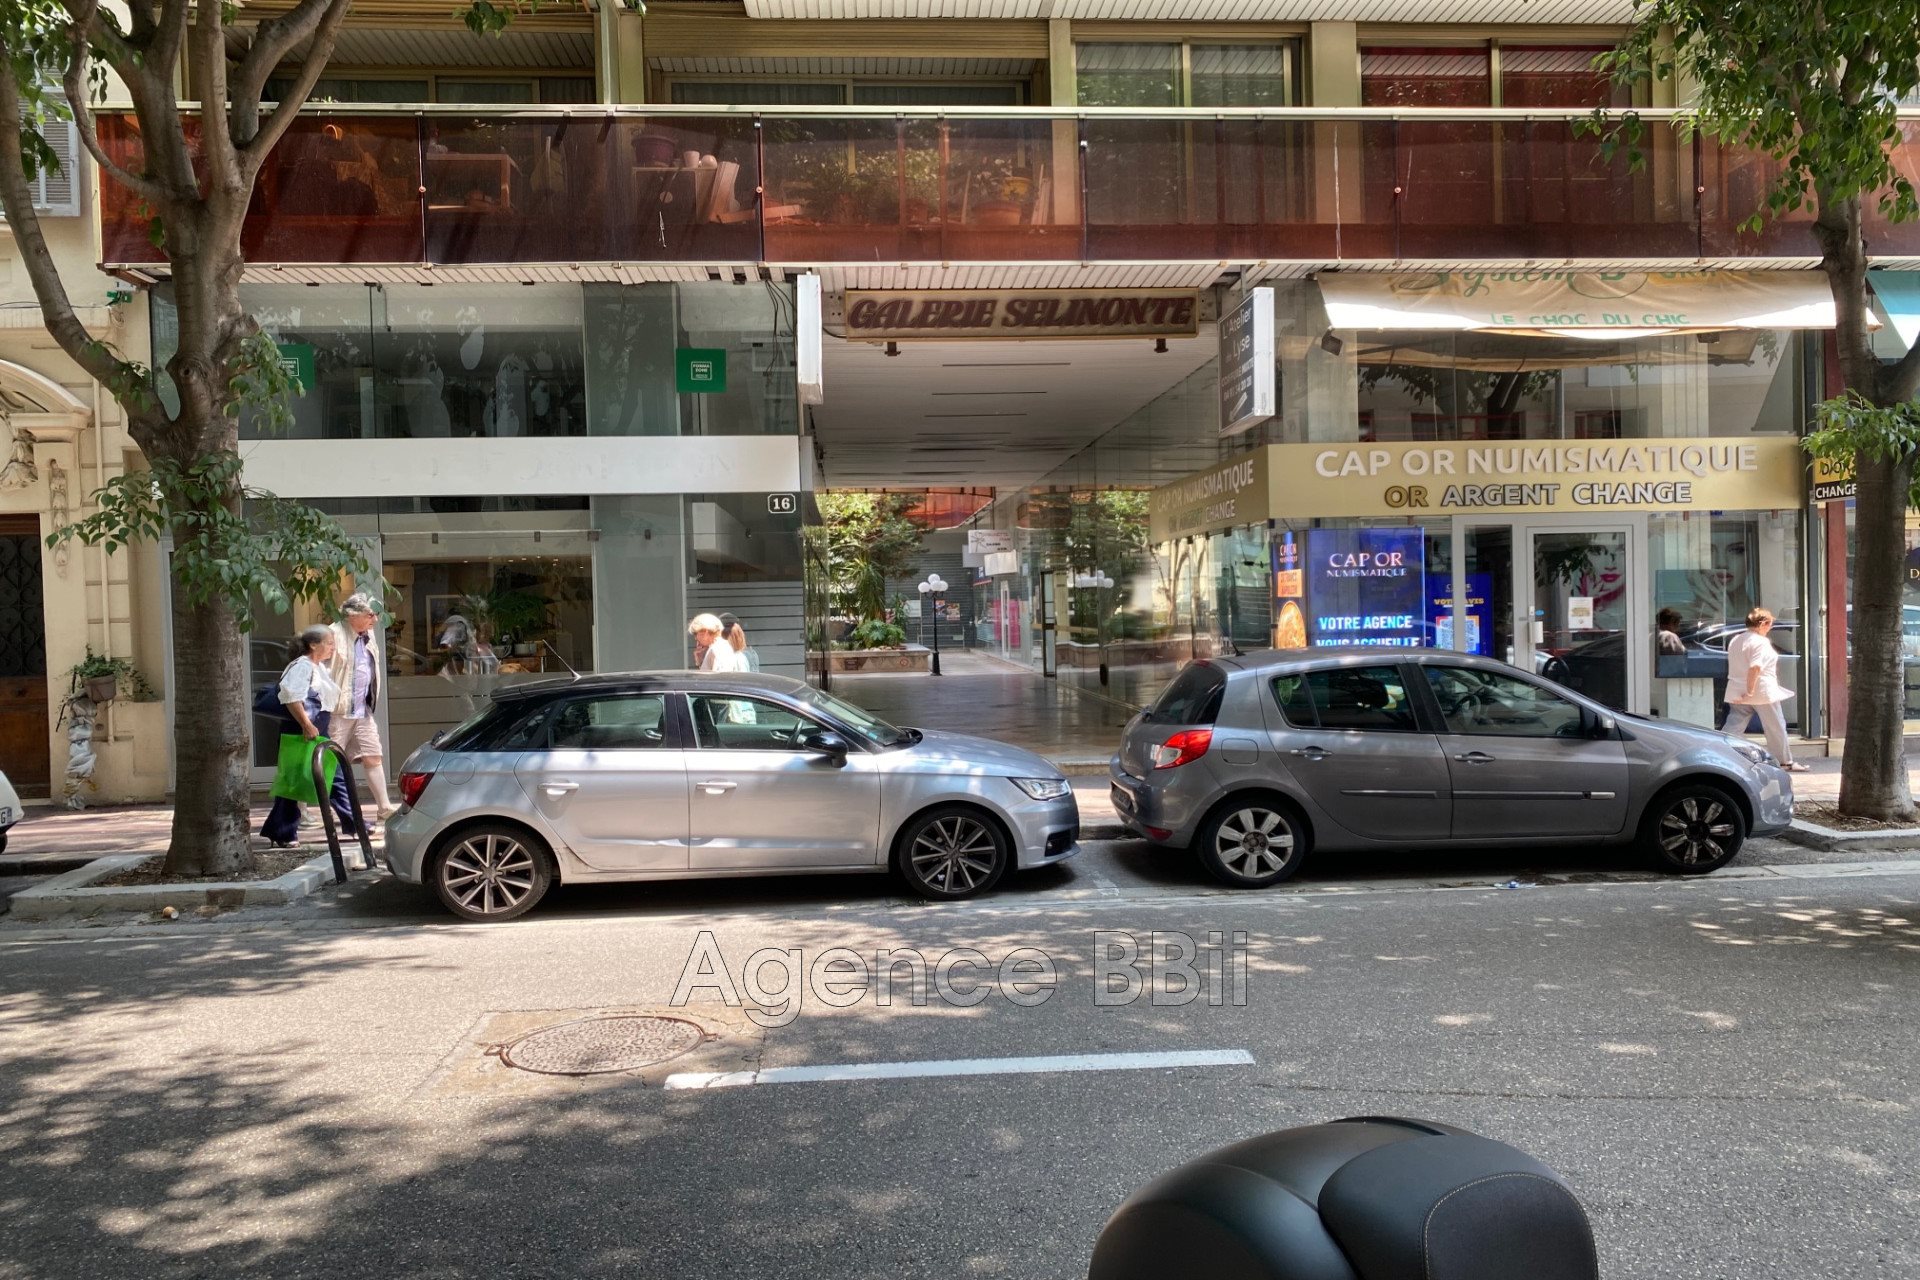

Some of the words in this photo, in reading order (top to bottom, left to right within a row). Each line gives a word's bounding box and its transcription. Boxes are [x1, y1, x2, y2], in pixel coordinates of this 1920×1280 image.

[850, 298, 999, 329] GALERIE
[1001, 297, 1195, 328] SELINONTE
[1490, 314, 1515, 325] LE
[1530, 314, 1588, 325] CHOC
[1603, 313, 1631, 325] DU
[1643, 313, 1690, 325] CHIC
[1315, 450, 1391, 478] CAP
[1402, 449, 1456, 475] OR
[1467, 445, 1758, 477] NUMISMATIQUE
[1184, 459, 1254, 502] NUMISMATIQUE
[1385, 485, 1429, 507] OR
[1440, 483, 1560, 506] ARGENT
[1572, 482, 1692, 504] CHANGE
[1815, 483, 1857, 499] CHANGE
[773, 497, 790, 510] 16
[1206, 499, 1236, 522] CHANGE
[1329, 553, 1370, 568] CAP
[1375, 552, 1403, 567] OR
[1326, 568, 1407, 577] NUMISMATIQUE
[1319, 617, 1361, 630] VOTRE
[1363, 615, 1413, 629] AGENCE
